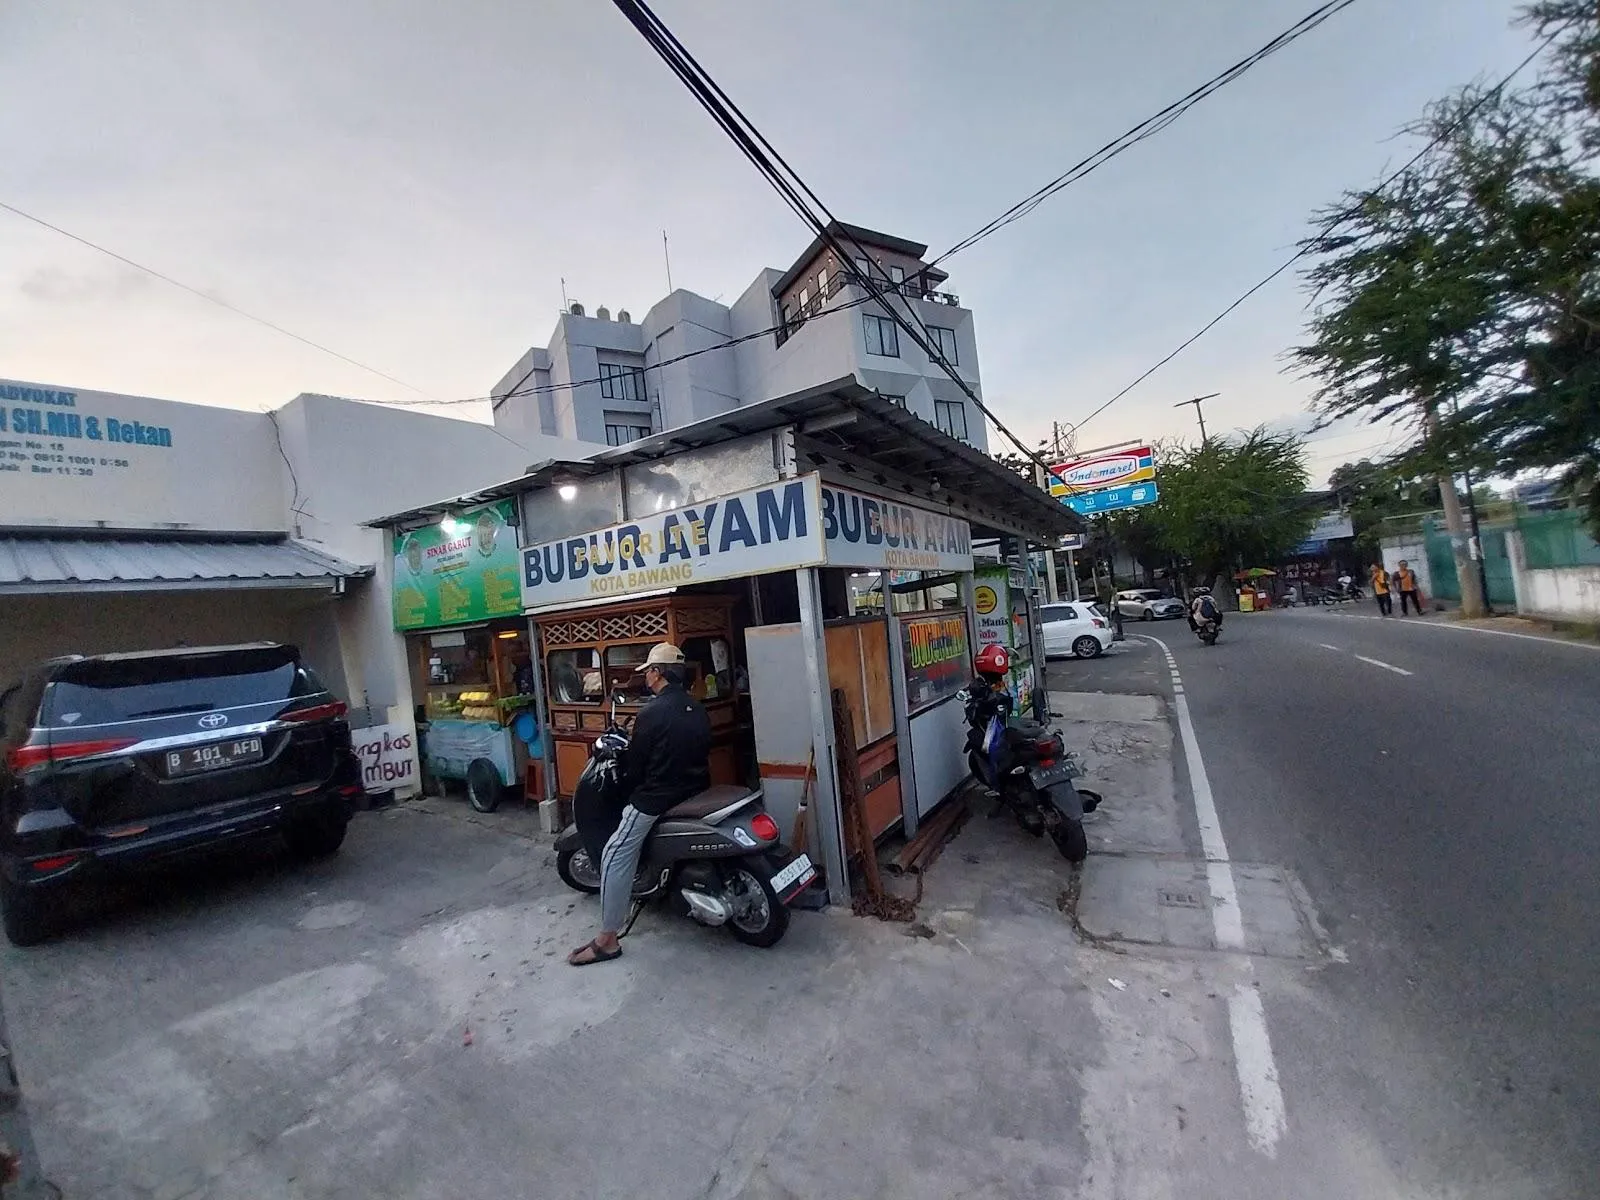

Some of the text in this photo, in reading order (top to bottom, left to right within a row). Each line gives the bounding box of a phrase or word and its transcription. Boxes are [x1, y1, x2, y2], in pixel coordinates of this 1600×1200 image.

[86, 416, 102, 440] &
[107, 417, 172, 447] Rekan
[1068, 461, 1133, 483] Indomaret
[821, 487, 919, 550] BUBUR
[524, 482, 808, 588] BUBUR AYAM
[590, 563, 693, 593] KOTA BAWANG
[170, 739, 260, 767] B 101 AFD
[365, 759, 412, 783] MBUT
